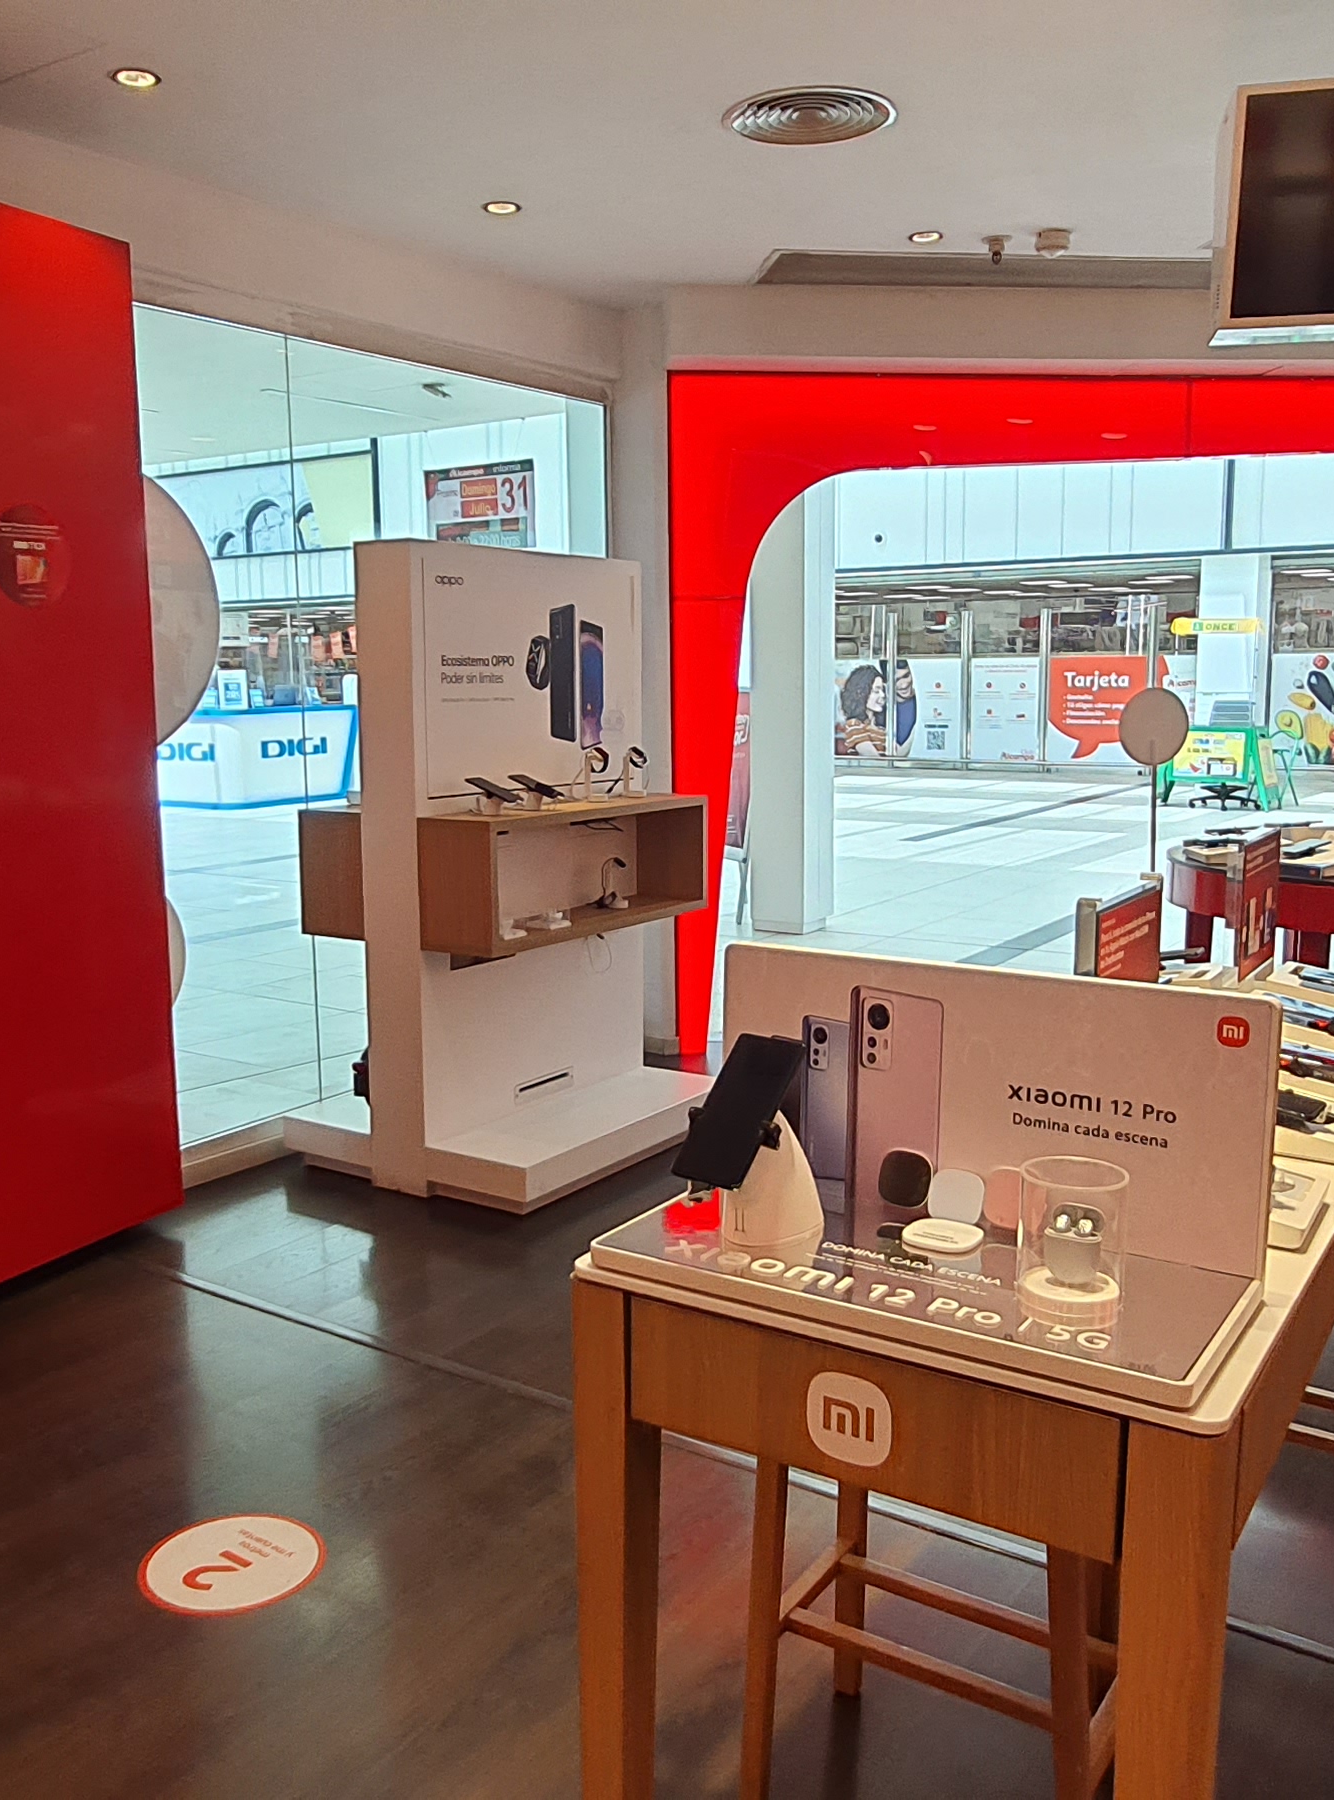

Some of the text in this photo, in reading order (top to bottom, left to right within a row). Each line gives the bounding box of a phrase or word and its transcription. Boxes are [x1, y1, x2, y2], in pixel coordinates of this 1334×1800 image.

[462, 474, 528, 513] Domingo 31
[470, 503, 491, 516] Julio
[1205, 623, 1236, 631] ONCE
[440, 654, 515, 667] Ecosistema OPPO
[440, 672, 465, 684] Poder
[465, 672, 478, 684] sin
[1064, 671, 1130, 691] Tarjeta
[261, 736, 327, 759] DIGI
[1110, 1099, 1133, 1118] 12
[1142, 1103, 1178, 1124] Pro
[1012, 1112, 1168, 1148] Domina cada escena
[821, 1240, 1003, 1286] DOMINA CADA ESCENA
[867, 1281, 918, 1310] 12
[925, 1294, 1002, 1327] Pro
[1044, 1325, 1113, 1352] 5G
[181, 1549, 254, 1591] 2
